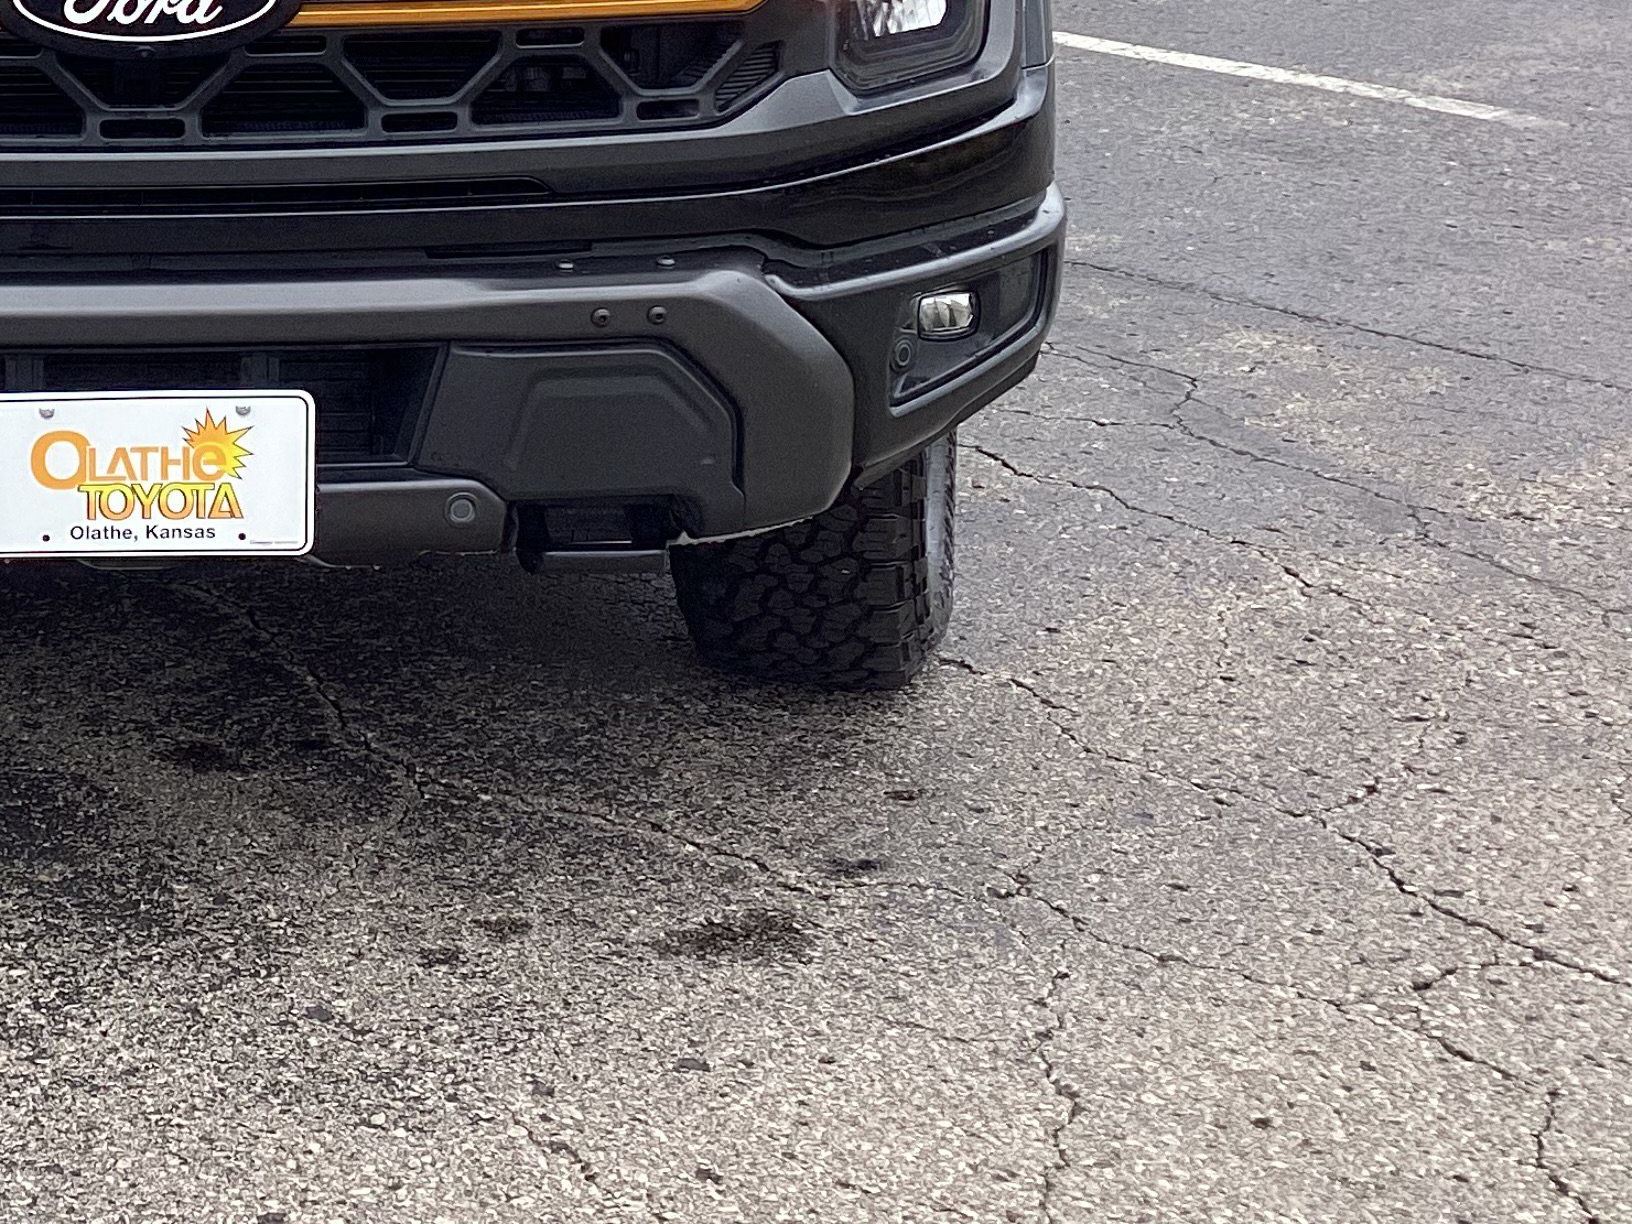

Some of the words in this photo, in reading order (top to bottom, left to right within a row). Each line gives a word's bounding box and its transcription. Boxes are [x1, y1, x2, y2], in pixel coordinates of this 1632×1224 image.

[77, 481, 244, 521] TOYOTA
[69, 524, 139, 543] Olathe,
[145, 524, 217, 539] Kansas
